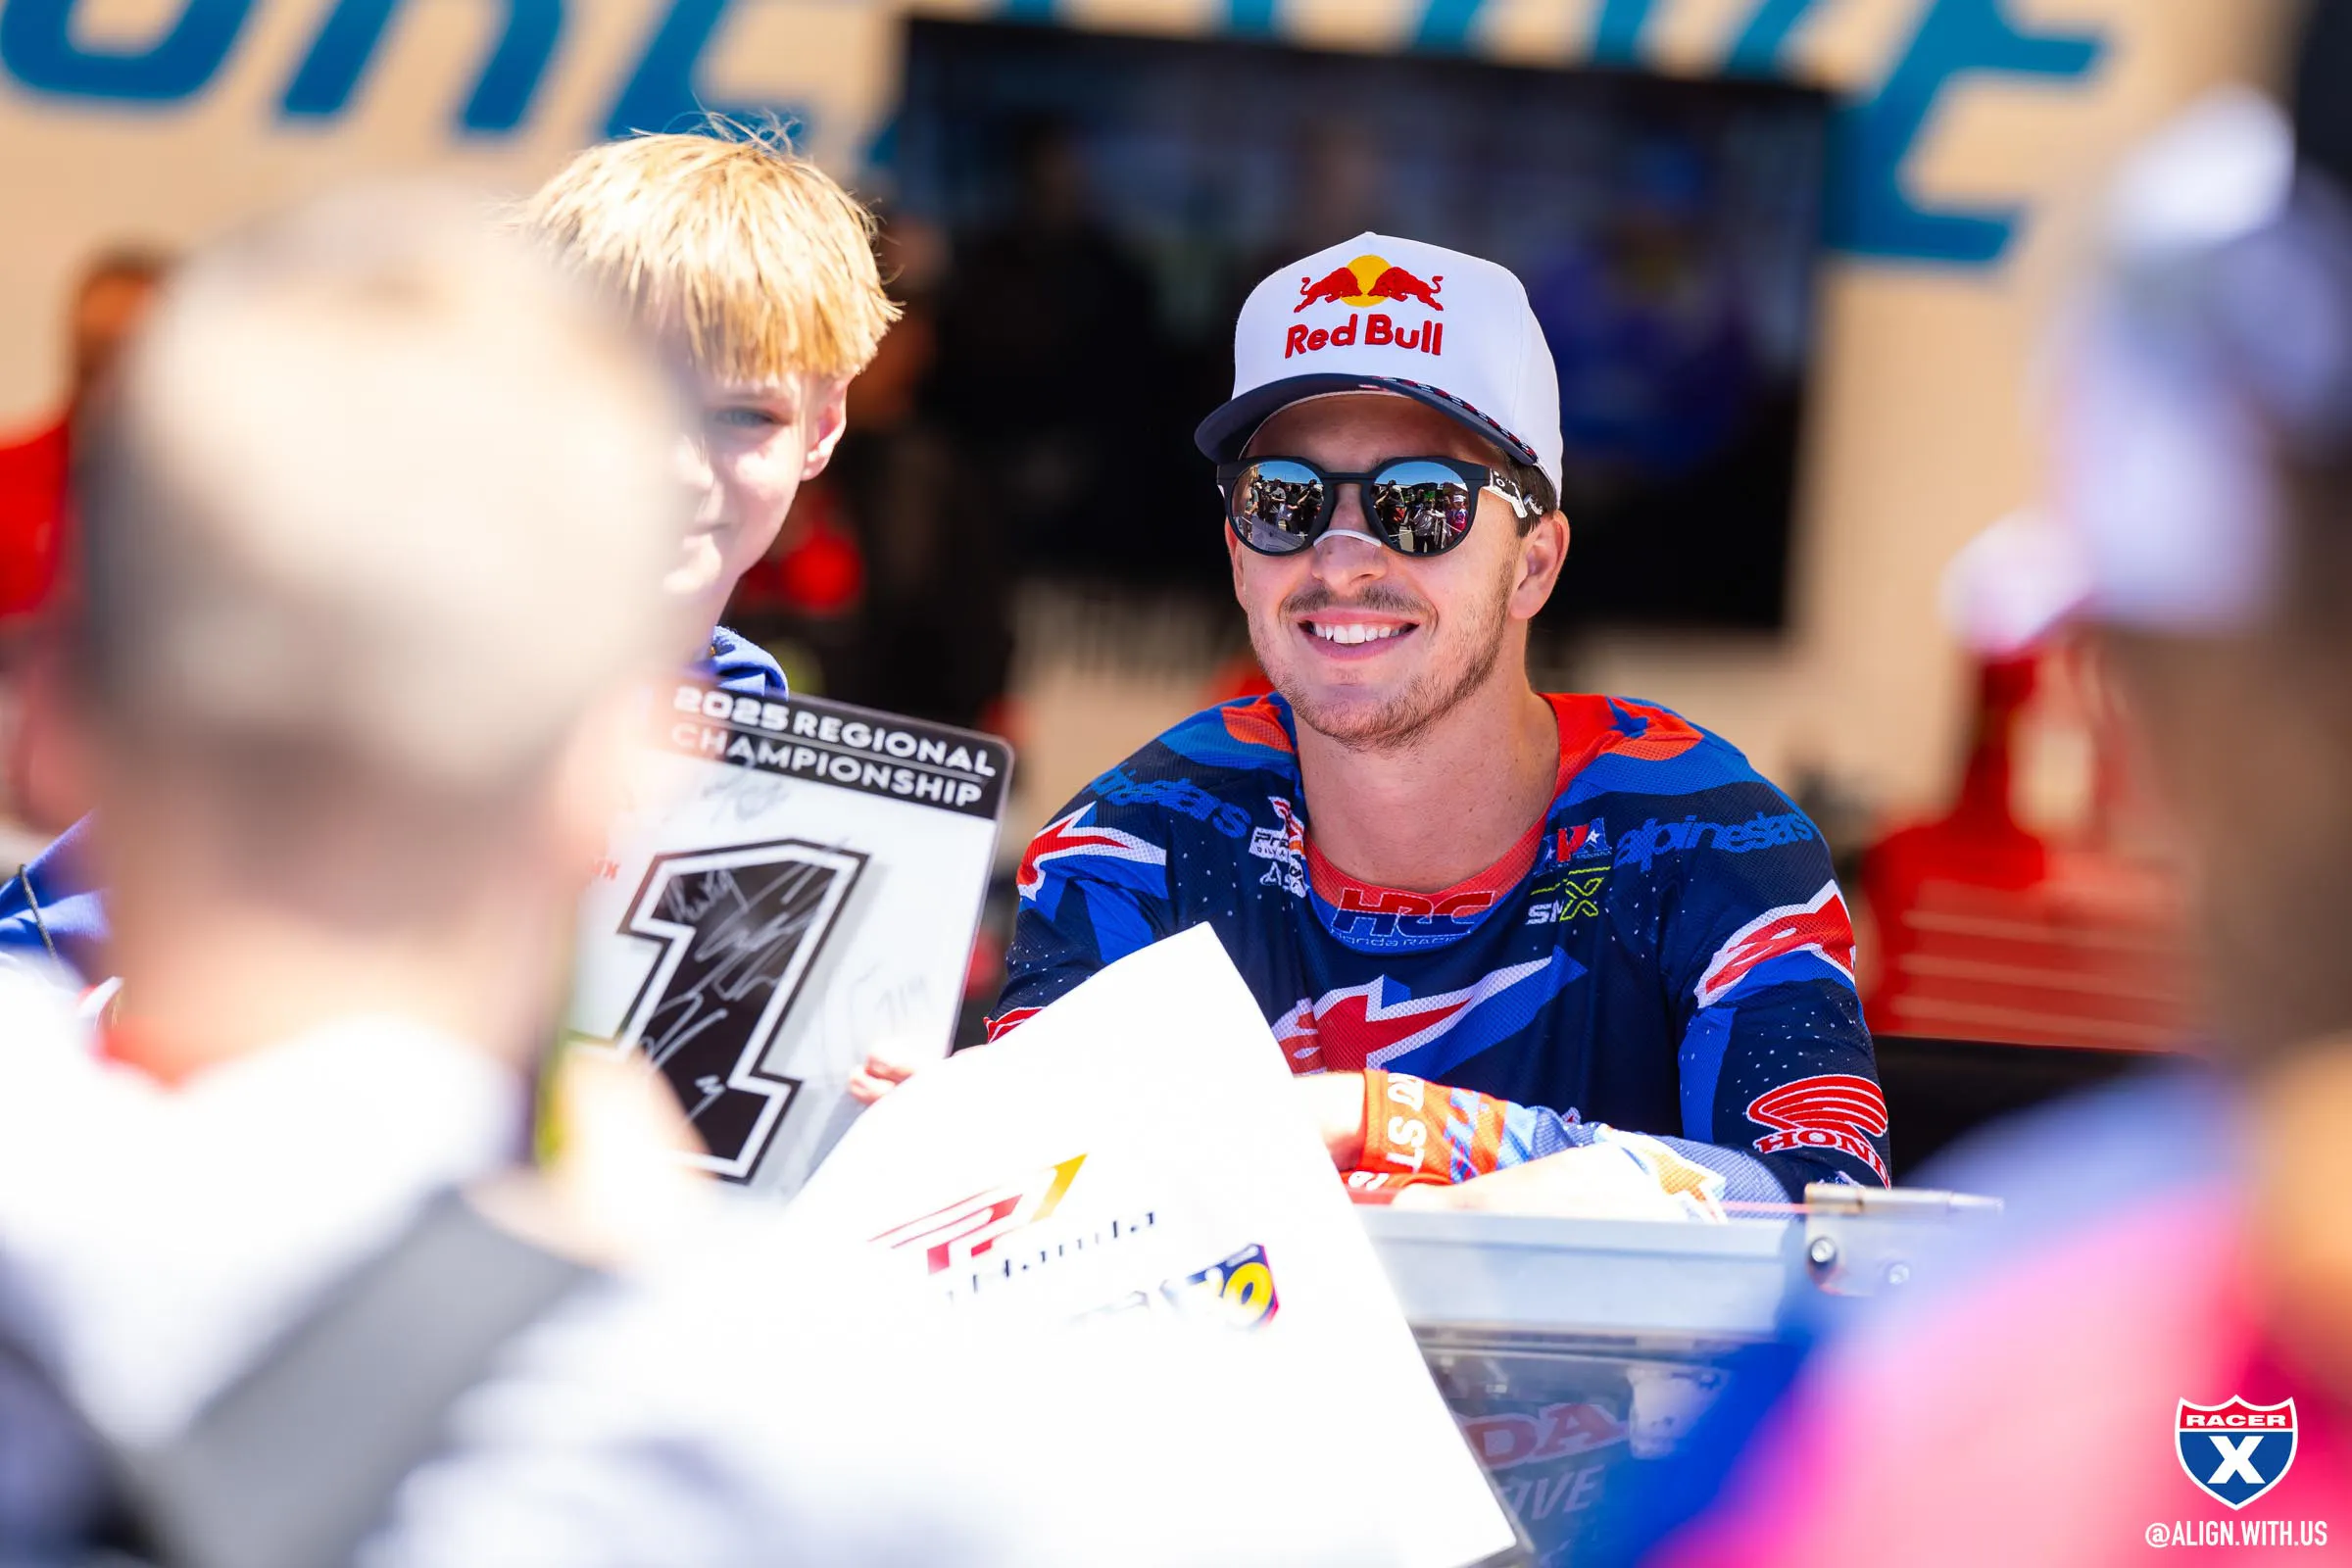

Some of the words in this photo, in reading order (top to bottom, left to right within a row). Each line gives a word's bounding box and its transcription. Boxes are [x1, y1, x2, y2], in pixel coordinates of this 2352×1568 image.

[1285, 314, 1358, 359] Red
[1364, 314, 1444, 356] Bull
[671, 722, 982, 807] CHAMPIONSHIP
[673, 687, 790, 731] 2025
[793, 710, 996, 777] REGIONAL
[1331, 887, 1496, 937] HRC
